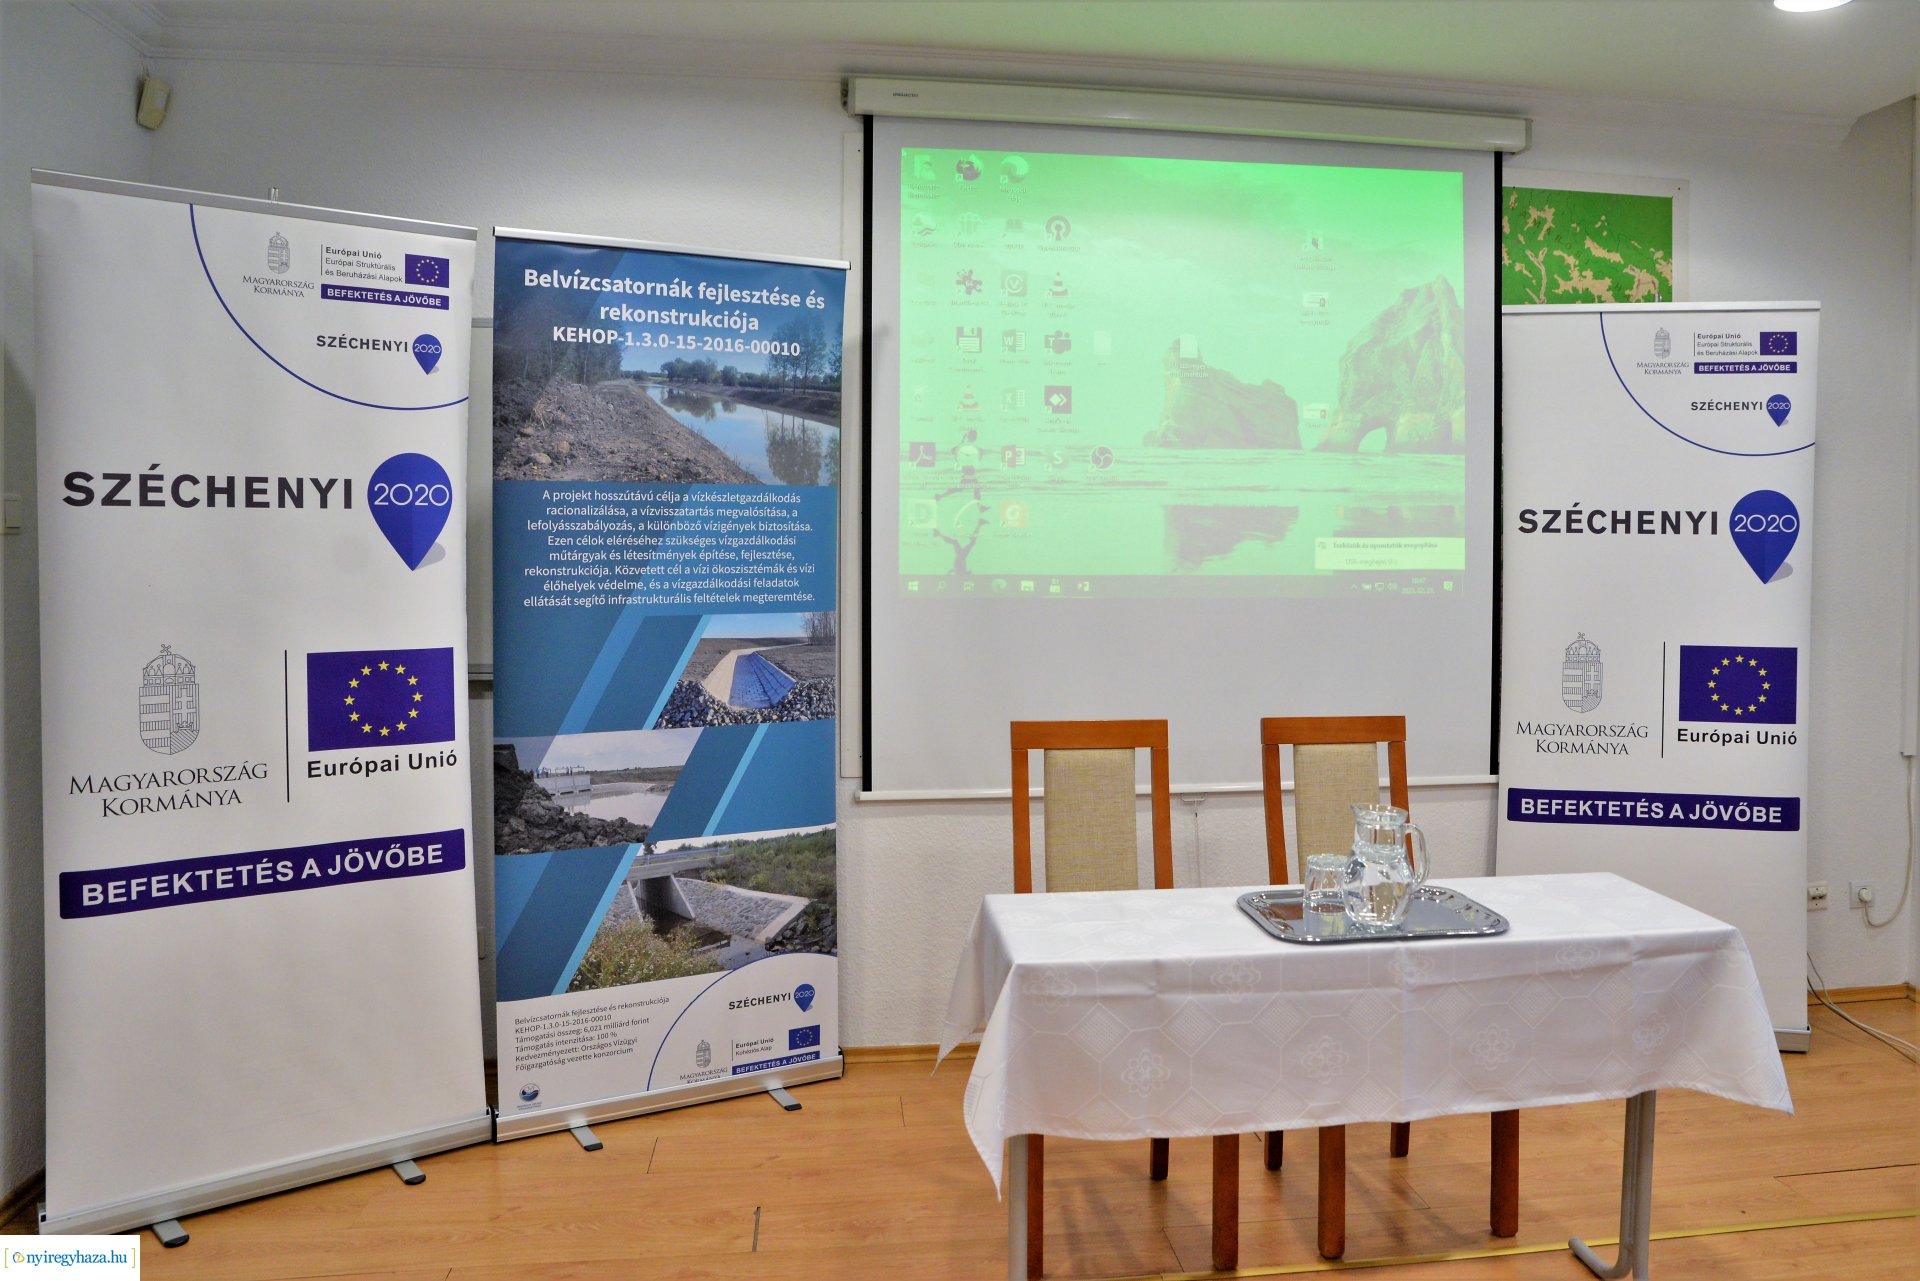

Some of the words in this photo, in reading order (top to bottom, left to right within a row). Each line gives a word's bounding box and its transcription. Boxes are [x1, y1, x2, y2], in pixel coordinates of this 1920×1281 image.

[325, 247, 360, 257] Európai
[362, 250, 382, 259] Unió
[325, 258, 354, 268] Európai
[242, 275, 315, 290] MAGYARORSZÁG
[324, 268, 334, 277] és
[336, 269, 377, 280] Beruházási
[378, 273, 403, 283] Alapok
[253, 285, 304, 298] KORMÁNYA
[327, 288, 393, 302] BEFEKTETÉS
[394, 294, 401, 302] A
[524, 268, 693, 299] Belvízcsatornák
[697, 282, 801, 307] fejlesztése
[805, 289, 825, 309] és
[600, 304, 759, 334] rekonstrukciója
[316, 334, 408, 353] SZÉCHENYI
[414, 344, 441, 354] 2020
[552, 326, 800, 357] KEHOP-1.3.0-15-2016-00010
[1698, 364, 1750, 372] BEFEKTETÉS
[1690, 399, 1763, 411] SZÉCHENYI
[1767, 402, 1791, 410] 2020
[62, 463, 353, 509] SZÉCHENYI
[373, 482, 450, 507] 2020
[542, 490, 550, 500] A
[553, 490, 592, 502] projekt
[594, 490, 654, 501] hosszútávú
[656, 491, 680, 503] célja
[691, 492, 801, 505] vízkészletgazdálkodás
[546, 505, 629, 517] racionalizálása,
[631, 508, 638, 516] a
[640, 505, 714, 516] vízvisszatartás
[716, 507, 790, 519] megvalósítása,
[1518, 502, 1718, 535] SZÉCHENYI
[1734, 514, 1797, 533] 2020
[527, 519, 636, 533] lefolyásszabályozás,
[638, 523, 645, 531] a
[647, 519, 701, 531] különböző
[703, 520, 755, 533] vízigények
[758, 520, 813, 532] biztosítása.
[547, 536, 574, 546] Ezen
[576, 535, 604, 546] célok
[606, 535, 663, 546] eléréséhez
[665, 535, 716, 547] szükséges
[718, 535, 796, 547] vízgazdálkodási
[549, 550, 607, 563] műtárgyak
[609, 551, 621, 560] és
[624, 550, 697, 562] létesítmények
[699, 549, 738, 561] építése,
[741, 549, 795, 561] fejlesztése,
[524, 565, 612, 577] rekonstrukciója.
[615, 565, 665, 575] Közvetett
[667, 565, 682, 574] cél
[692, 564, 710, 574] vízi
[711, 563, 785, 574] ökoszisztémák
[786, 563, 798, 573] és
[799, 563, 815, 573] vízi
[543, 580, 595, 593] élőhelyek
[598, 579, 647, 592] védelme,
[649, 579, 661, 589] és
[663, 581, 669, 589] a
[672, 579, 751, 591] vízgazdálkodási
[753, 578, 799, 588] feladatok
[523, 596, 572, 607] ellátását
[573, 594, 606, 608] segítő
[608, 593, 692, 605] infrastrukturális
[693, 592, 740, 603] feltételek
[743, 592, 815, 605] megteremtése.
[1516, 720, 1649, 739] MAGYARORSZÁG
[1677, 728, 1750, 747] Európai
[1757, 729, 1798, 746] Unió
[1535, 739, 1629, 756] KORMÁNYA
[307, 753, 400, 779] Európai
[408, 750, 458, 772] Unió
[68, 761, 269, 795] MAGYARORSZÁG
[101, 788, 243, 818] KORMÁNYA
[1521, 797, 1664, 820] BEFEKTETÉS
[1668, 803, 1684, 820] A
[1689, 799, 1782, 823] JÖVŐBE
[82, 858, 294, 906] BEFEKTETÉS
[301, 858, 321, 879] A
[327, 843, 443, 877] JÖVŐBE
[728, 992, 791, 1010] SZÉCHENYI
[794, 989, 815, 999] 2020
[514, 1010, 570, 1025] Belvízcsatornák
[571, 1006, 608, 1017] fejlesztése
[617, 996, 670, 1010] rekonstrukciója
[514, 1014, 612, 1035] KEHOP-1.3.0-15-2016-00010
[515, 1031, 556, 1044] Támogatási
[557, 1028, 583, 1039] összeg:
[583, 1024, 602, 1033] 6,021
[603, 1020, 630, 1030] milliárd
[631, 1017, 650, 1026] forint
[515, 1041, 554, 1054] Támogatás
[555, 1035, 596, 1047] intenzitása:
[597, 1033, 609, 1041] 100
[515, 1047, 580, 1062] Kedvezményezett:
[580, 1041, 613, 1052] Országos
[613, 1037, 638, 1048] Vízügyi
[735, 1040, 759, 1049] Európai
[760, 1037, 774, 1045] Unió
[760, 1045, 772, 1053] Alap
[515, 1058, 566, 1072] Főigazgatóság
[567, 1054, 592, 1063] vezette
[593, 1047, 633, 1059] konzorcium
[736, 1060, 781, 1074] BEFEKTETÉS
[680, 1067, 727, 1080] MAGYARORSZÁG
